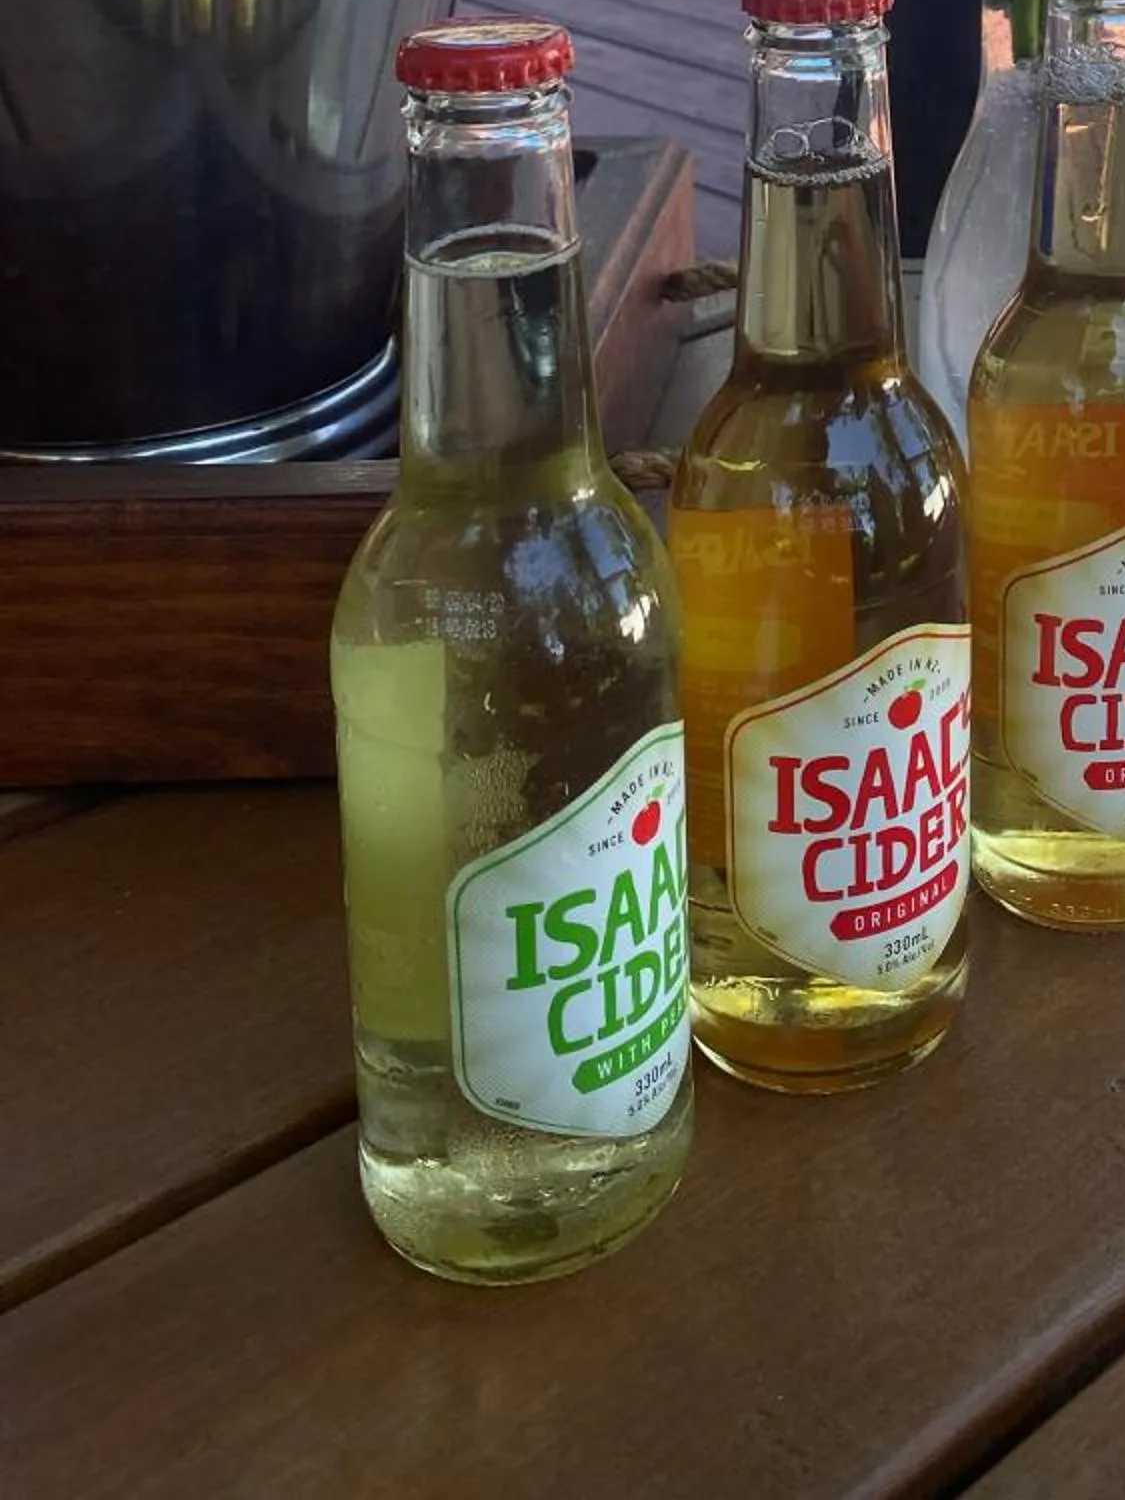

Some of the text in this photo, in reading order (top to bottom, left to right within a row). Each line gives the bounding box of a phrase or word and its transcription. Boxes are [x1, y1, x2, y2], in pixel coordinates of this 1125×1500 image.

[867, 663, 903, 697] MADE
[909, 657, 922, 672] IN
[843, 711, 880, 729] SINCE
[611, 773, 644, 815] MADE
[587, 829, 625, 858] SINCE
[802, 778, 967, 903] CIDER
[855, 875, 948, 933] ORIGINAL
[597, 1033, 652, 1080] WITH
